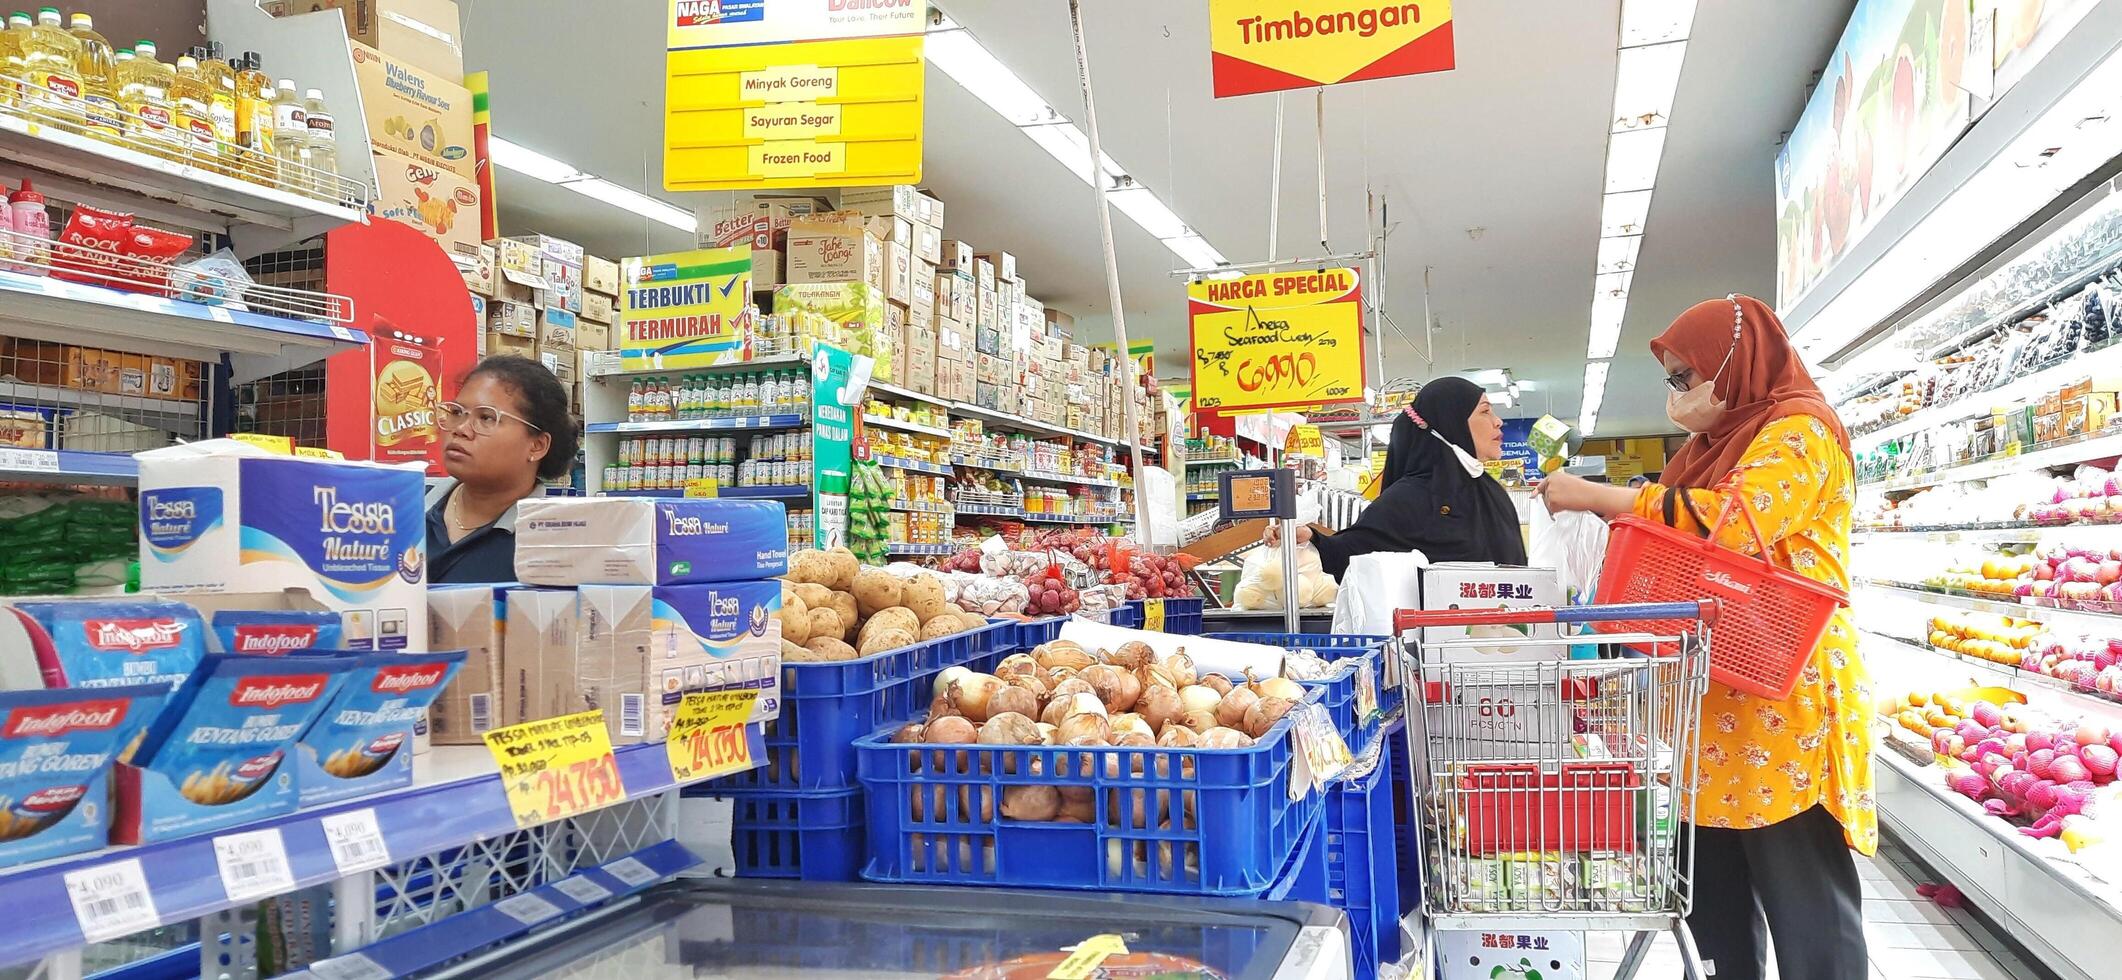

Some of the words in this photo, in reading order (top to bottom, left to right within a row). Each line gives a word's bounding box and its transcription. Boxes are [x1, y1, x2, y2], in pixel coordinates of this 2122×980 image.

[678, 0, 720, 17] NAGA
[870, 13, 888, 21] Their
[890, 11, 915, 19] Future
[1237, 3, 1420, 45] Timbangan
[385, 61, 425, 90] Walens
[745, 77, 787, 92] Minyak
[790, 75, 833, 91] Goreng
[385, 77, 416, 99] Blueberry
[751, 114, 797, 130] Sayuran
[800, 113, 834, 129] Segar
[762, 152, 800, 165] Frozen
[803, 150, 831, 163] Food
[383, 207, 405, 219] Soft
[714, 213, 755, 238] Better
[70, 232, 120, 252] ROCK
[627, 283, 710, 310] TERBUKTI
[1208, 279, 1267, 302] HARGA
[1273, 273, 1349, 297] SPECIAL
[627, 313, 721, 341] TERMURAH
[1245, 304, 1290, 332] Aneka
[1224, 326, 1280, 347] Seafood
[377, 410, 435, 436] CLASSIC
[147, 496, 197, 520] Tessa
[313, 485, 396, 534] Tessa
[665, 510, 702, 536] Tessa
[704, 518, 729, 534] Naturé
[322, 537, 390, 561] Naturé
[757, 551, 771, 560] Hand
[368, 563, 391, 572] Tissue
[1460, 582, 1534, 599] 泓都果业
[709, 591, 740, 617] Tessa
[242, 634, 311, 654] Indofood
[379, 670, 439, 690] Indofood
[239, 684, 320, 706] Indofood
[685, 695, 705, 706] TESSA
[13, 708, 119, 734] Indofood
[334, 709, 383, 726] KENTANG
[187, 724, 256, 744] KENTANG
[488, 729, 528, 746] TESSA
[1481, 932, 1550, 951] 泓都果业
